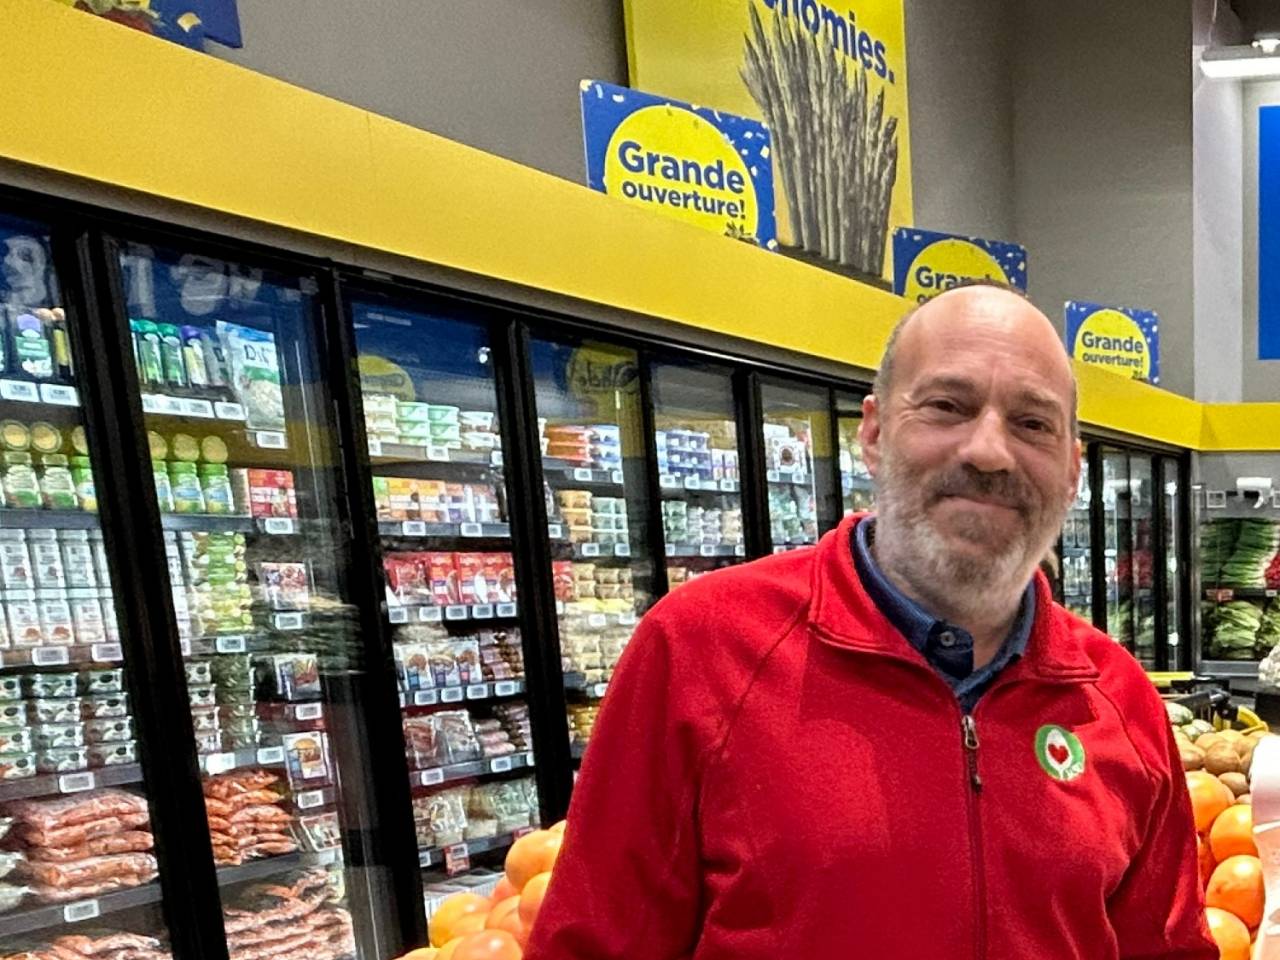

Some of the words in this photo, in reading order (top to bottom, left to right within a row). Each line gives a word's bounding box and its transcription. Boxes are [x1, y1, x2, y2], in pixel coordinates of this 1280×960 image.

[617, 140, 745, 195] Grande
[621, 181, 746, 220] ouverture!
[1082, 331, 1144, 354] Grande
[1082, 351, 1144, 368] ouverture!
